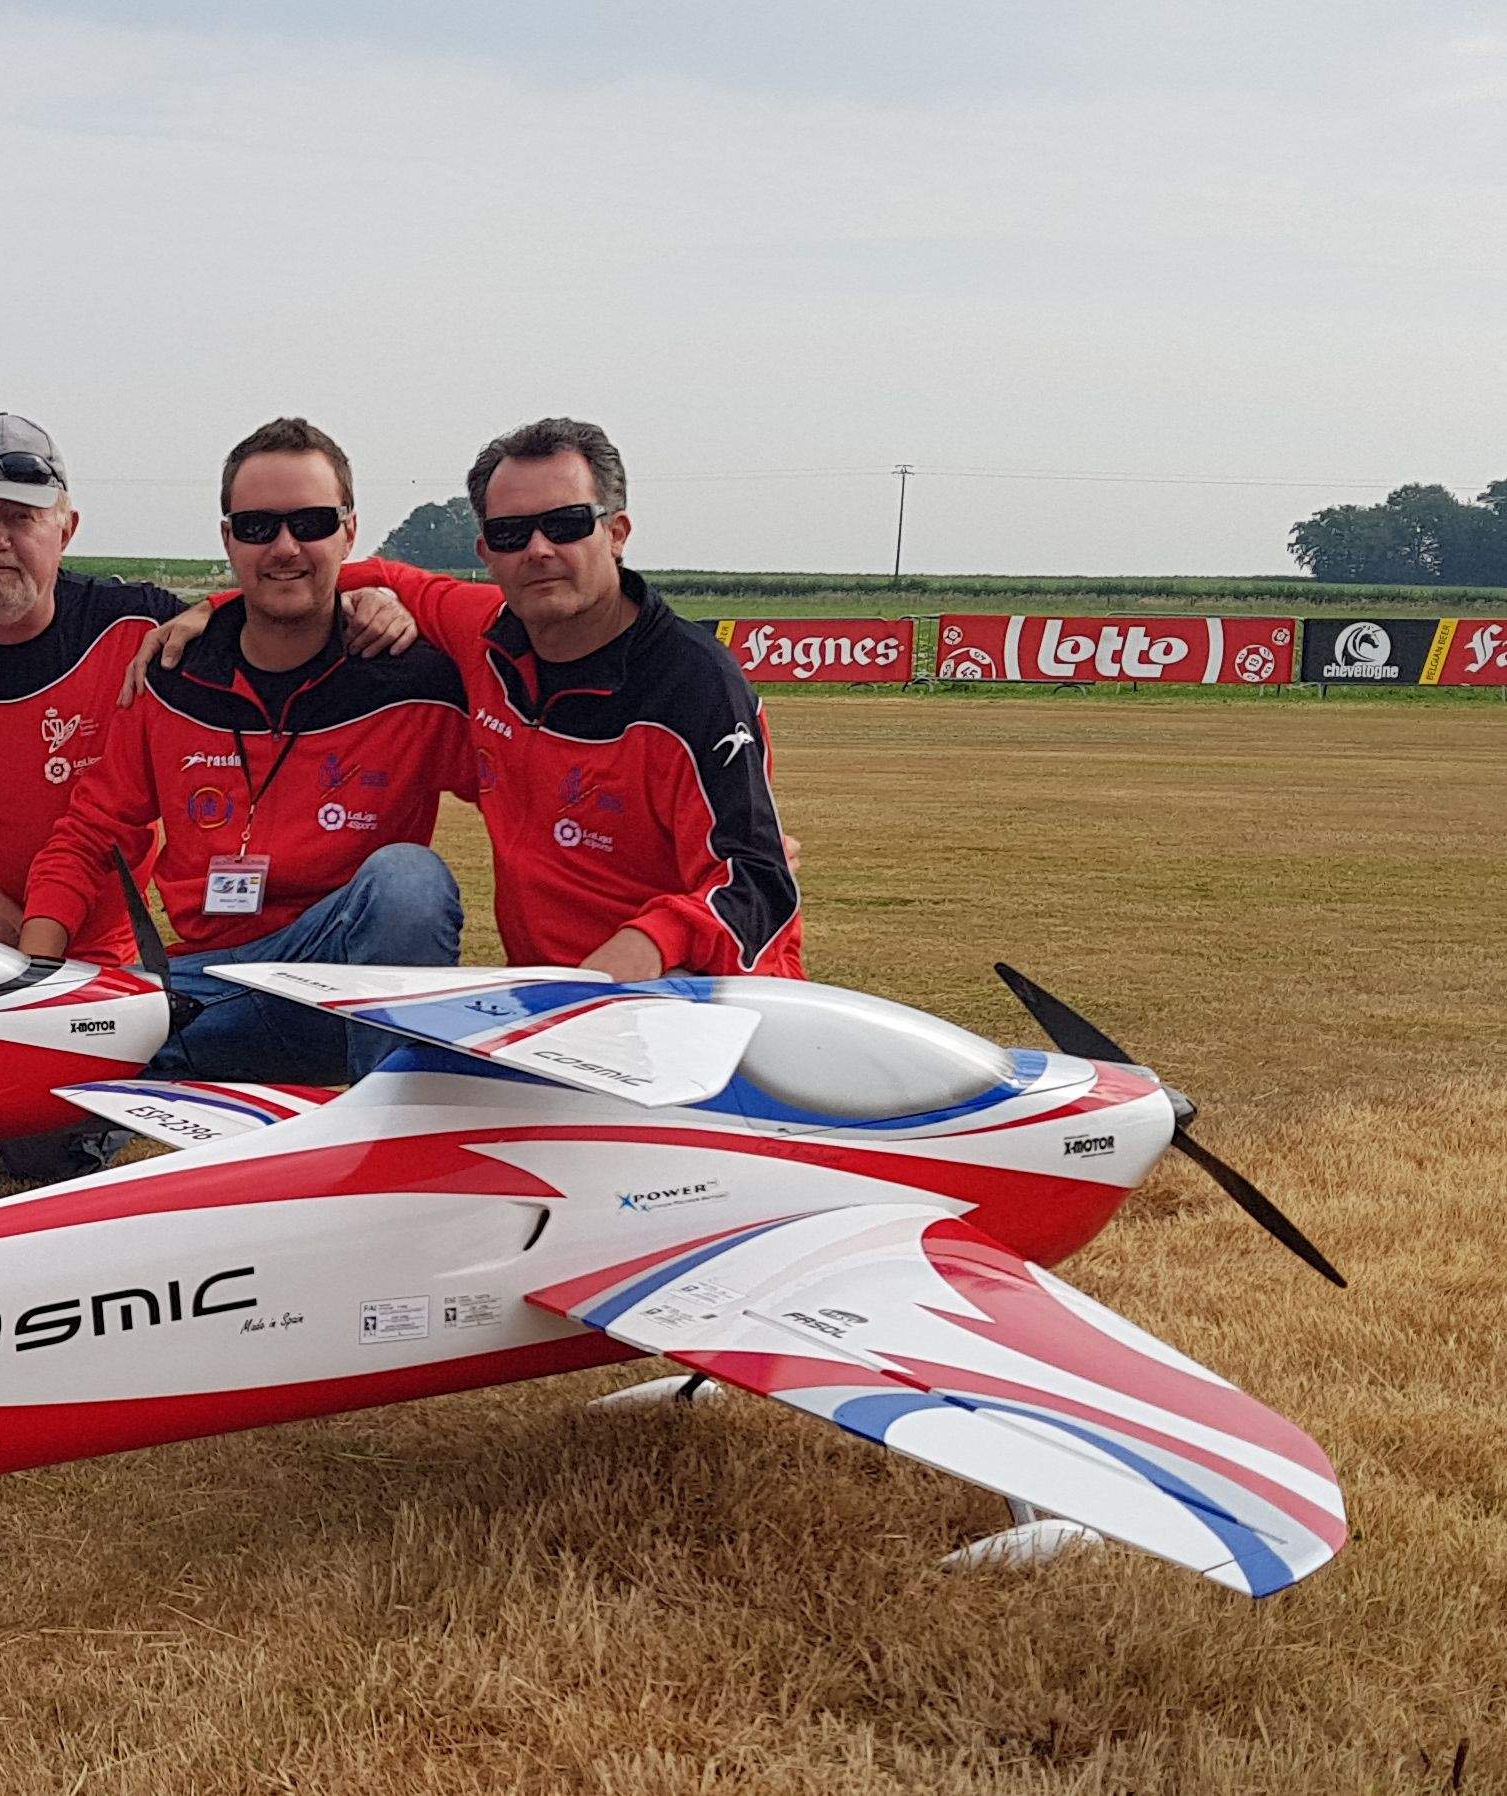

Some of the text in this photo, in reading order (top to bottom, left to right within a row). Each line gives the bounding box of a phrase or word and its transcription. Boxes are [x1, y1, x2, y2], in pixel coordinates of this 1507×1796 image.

[70, 1020, 116, 1034] X-MOTOR
[532, 1050, 654, 1087] COSMIC
[125, 1105, 223, 1140] ESP-2396
[1063, 1135, 1115, 1156] X-MOTOR
